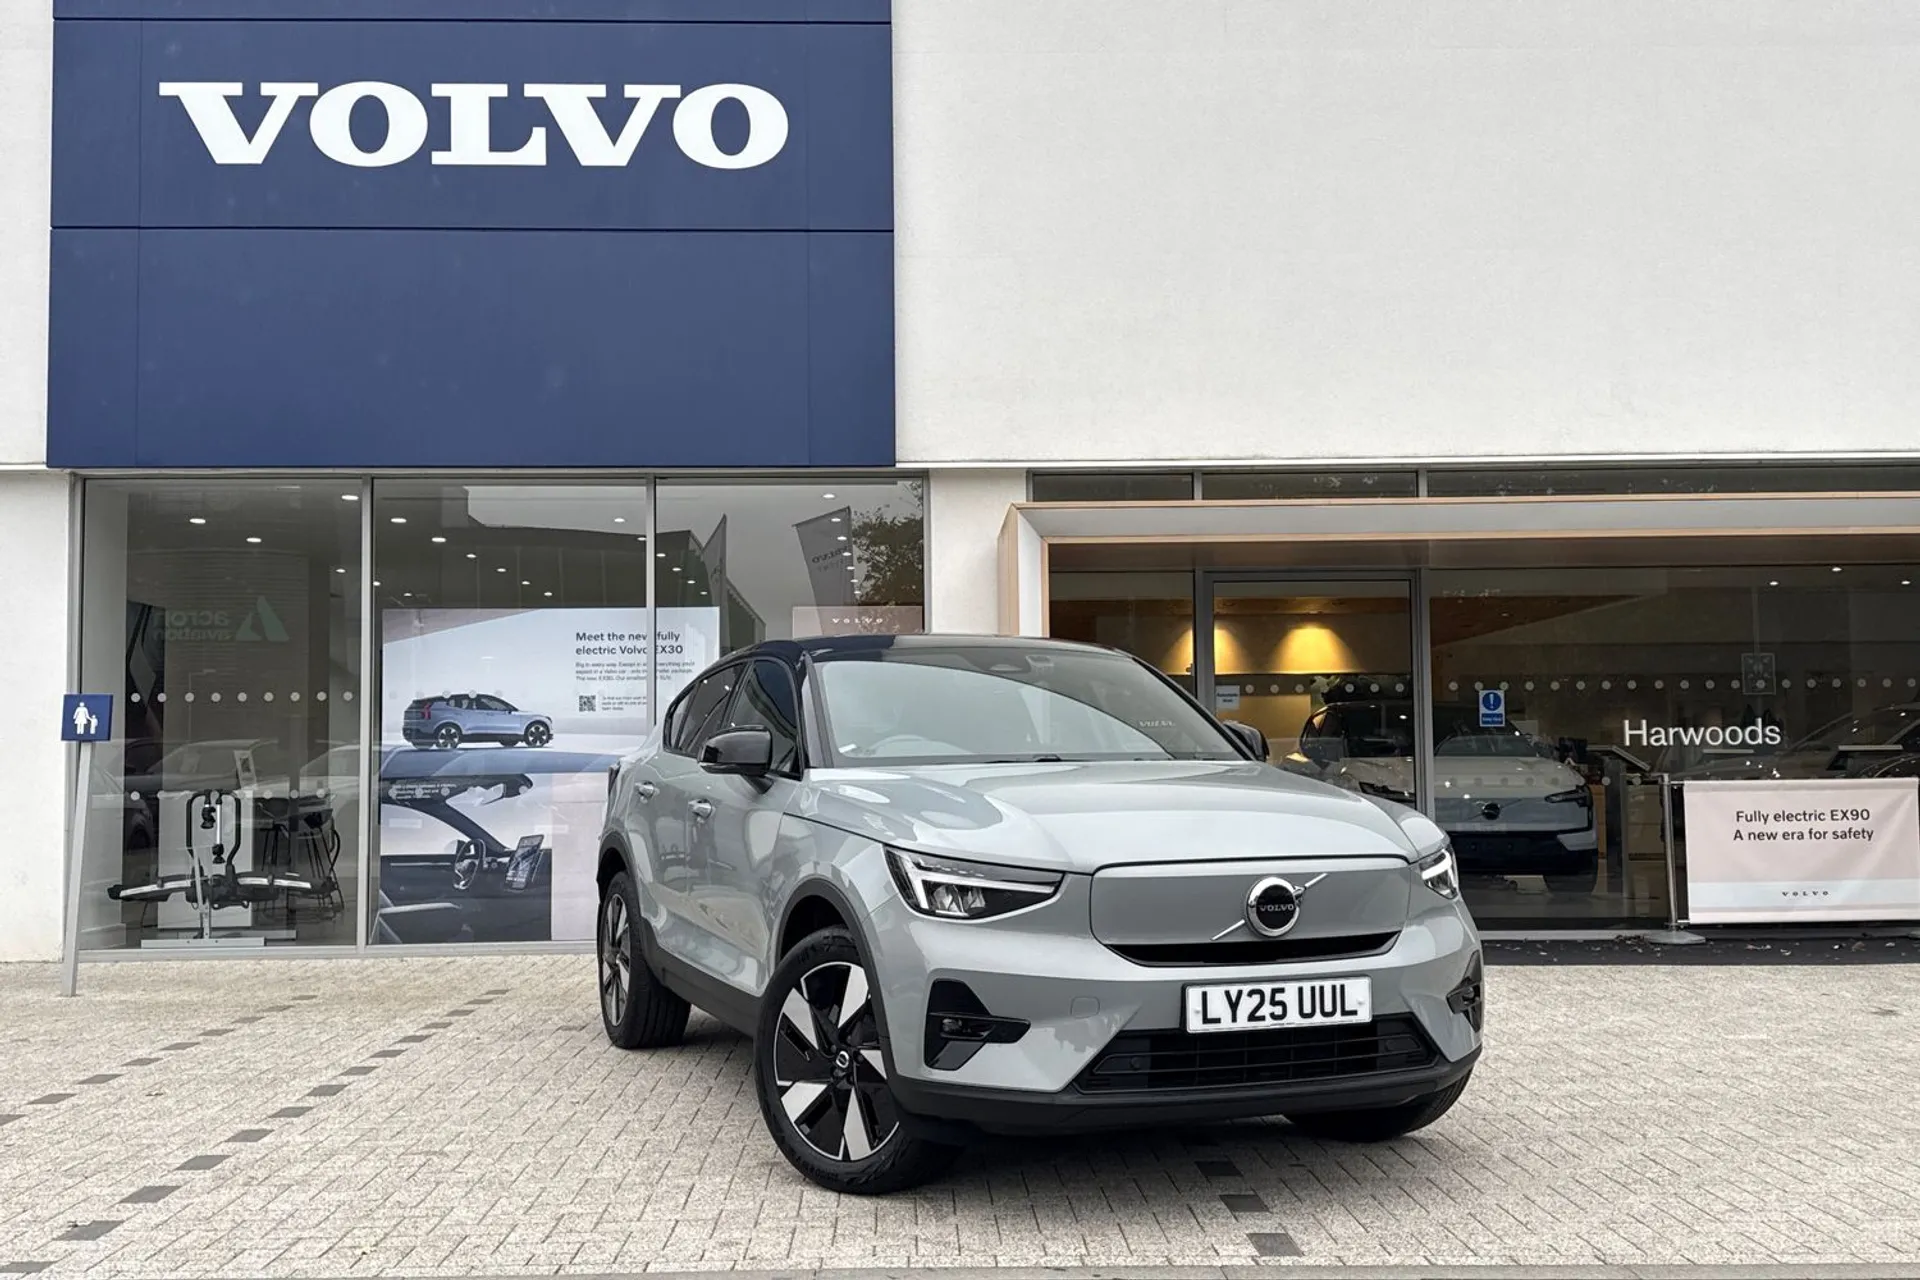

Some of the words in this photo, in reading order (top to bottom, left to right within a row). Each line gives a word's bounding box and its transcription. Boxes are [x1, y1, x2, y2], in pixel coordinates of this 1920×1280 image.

[159, 81, 789, 170] VOLVO
[576, 632, 605, 641] Meet
[607, 632, 625, 641] the
[656, 631, 680, 642] fully
[575, 645, 617, 655] electric
[1623, 717, 1782, 747] Harwoods
[1736, 810, 1769, 825] Fully
[1773, 809, 1826, 822] electric
[1830, 808, 1871, 821] EX90
[1733, 829, 1744, 841] A
[1747, 831, 1778, 841] new
[1782, 830, 1805, 840] era
[1808, 828, 1828, 840] for
[1832, 828, 1874, 842] safety
[1260, 903, 1295, 912] VOLVO
[1201, 987, 1288, 1025] LY25
[1298, 984, 1358, 1019] UUL
